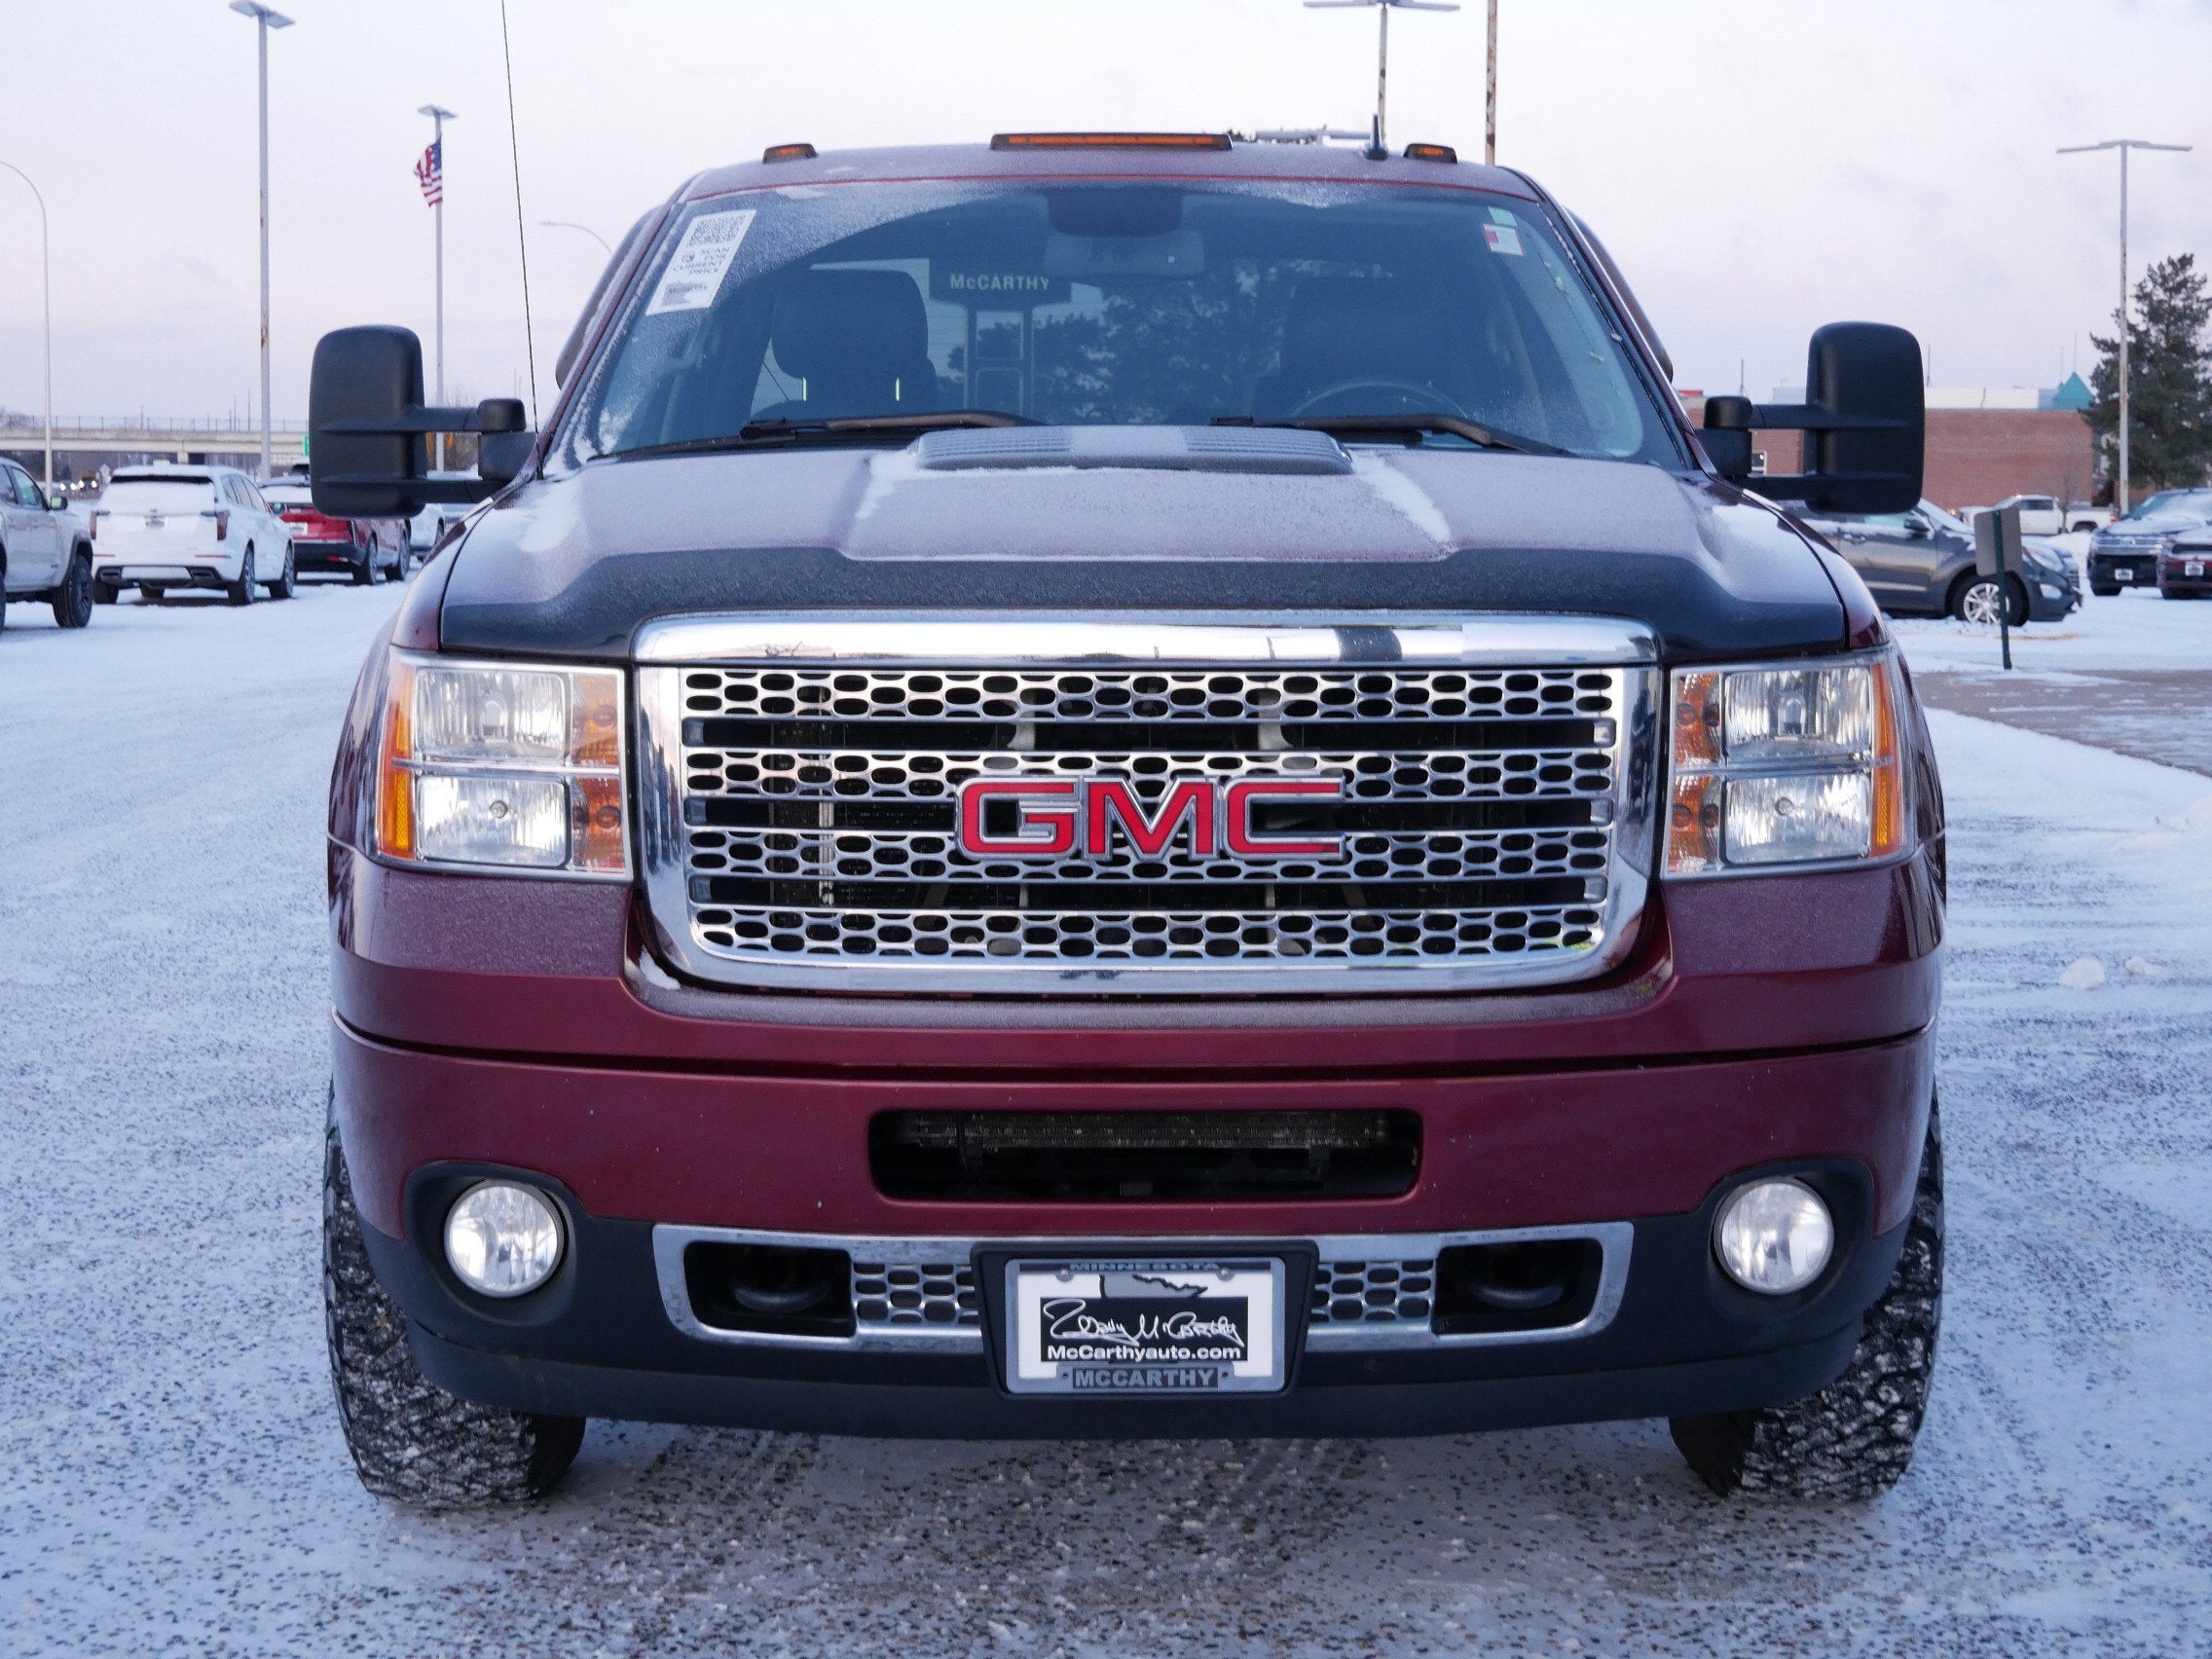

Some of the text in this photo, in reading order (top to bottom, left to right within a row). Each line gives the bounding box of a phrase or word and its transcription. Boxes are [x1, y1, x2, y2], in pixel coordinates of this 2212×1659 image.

[949, 274, 1050, 290] McCARTHY
[955, 775, 1346, 861] GMC
[1048, 1345, 1241, 1362] McCarthyauto.com
[1075, 1369, 1213, 1387] MCCARTHY
